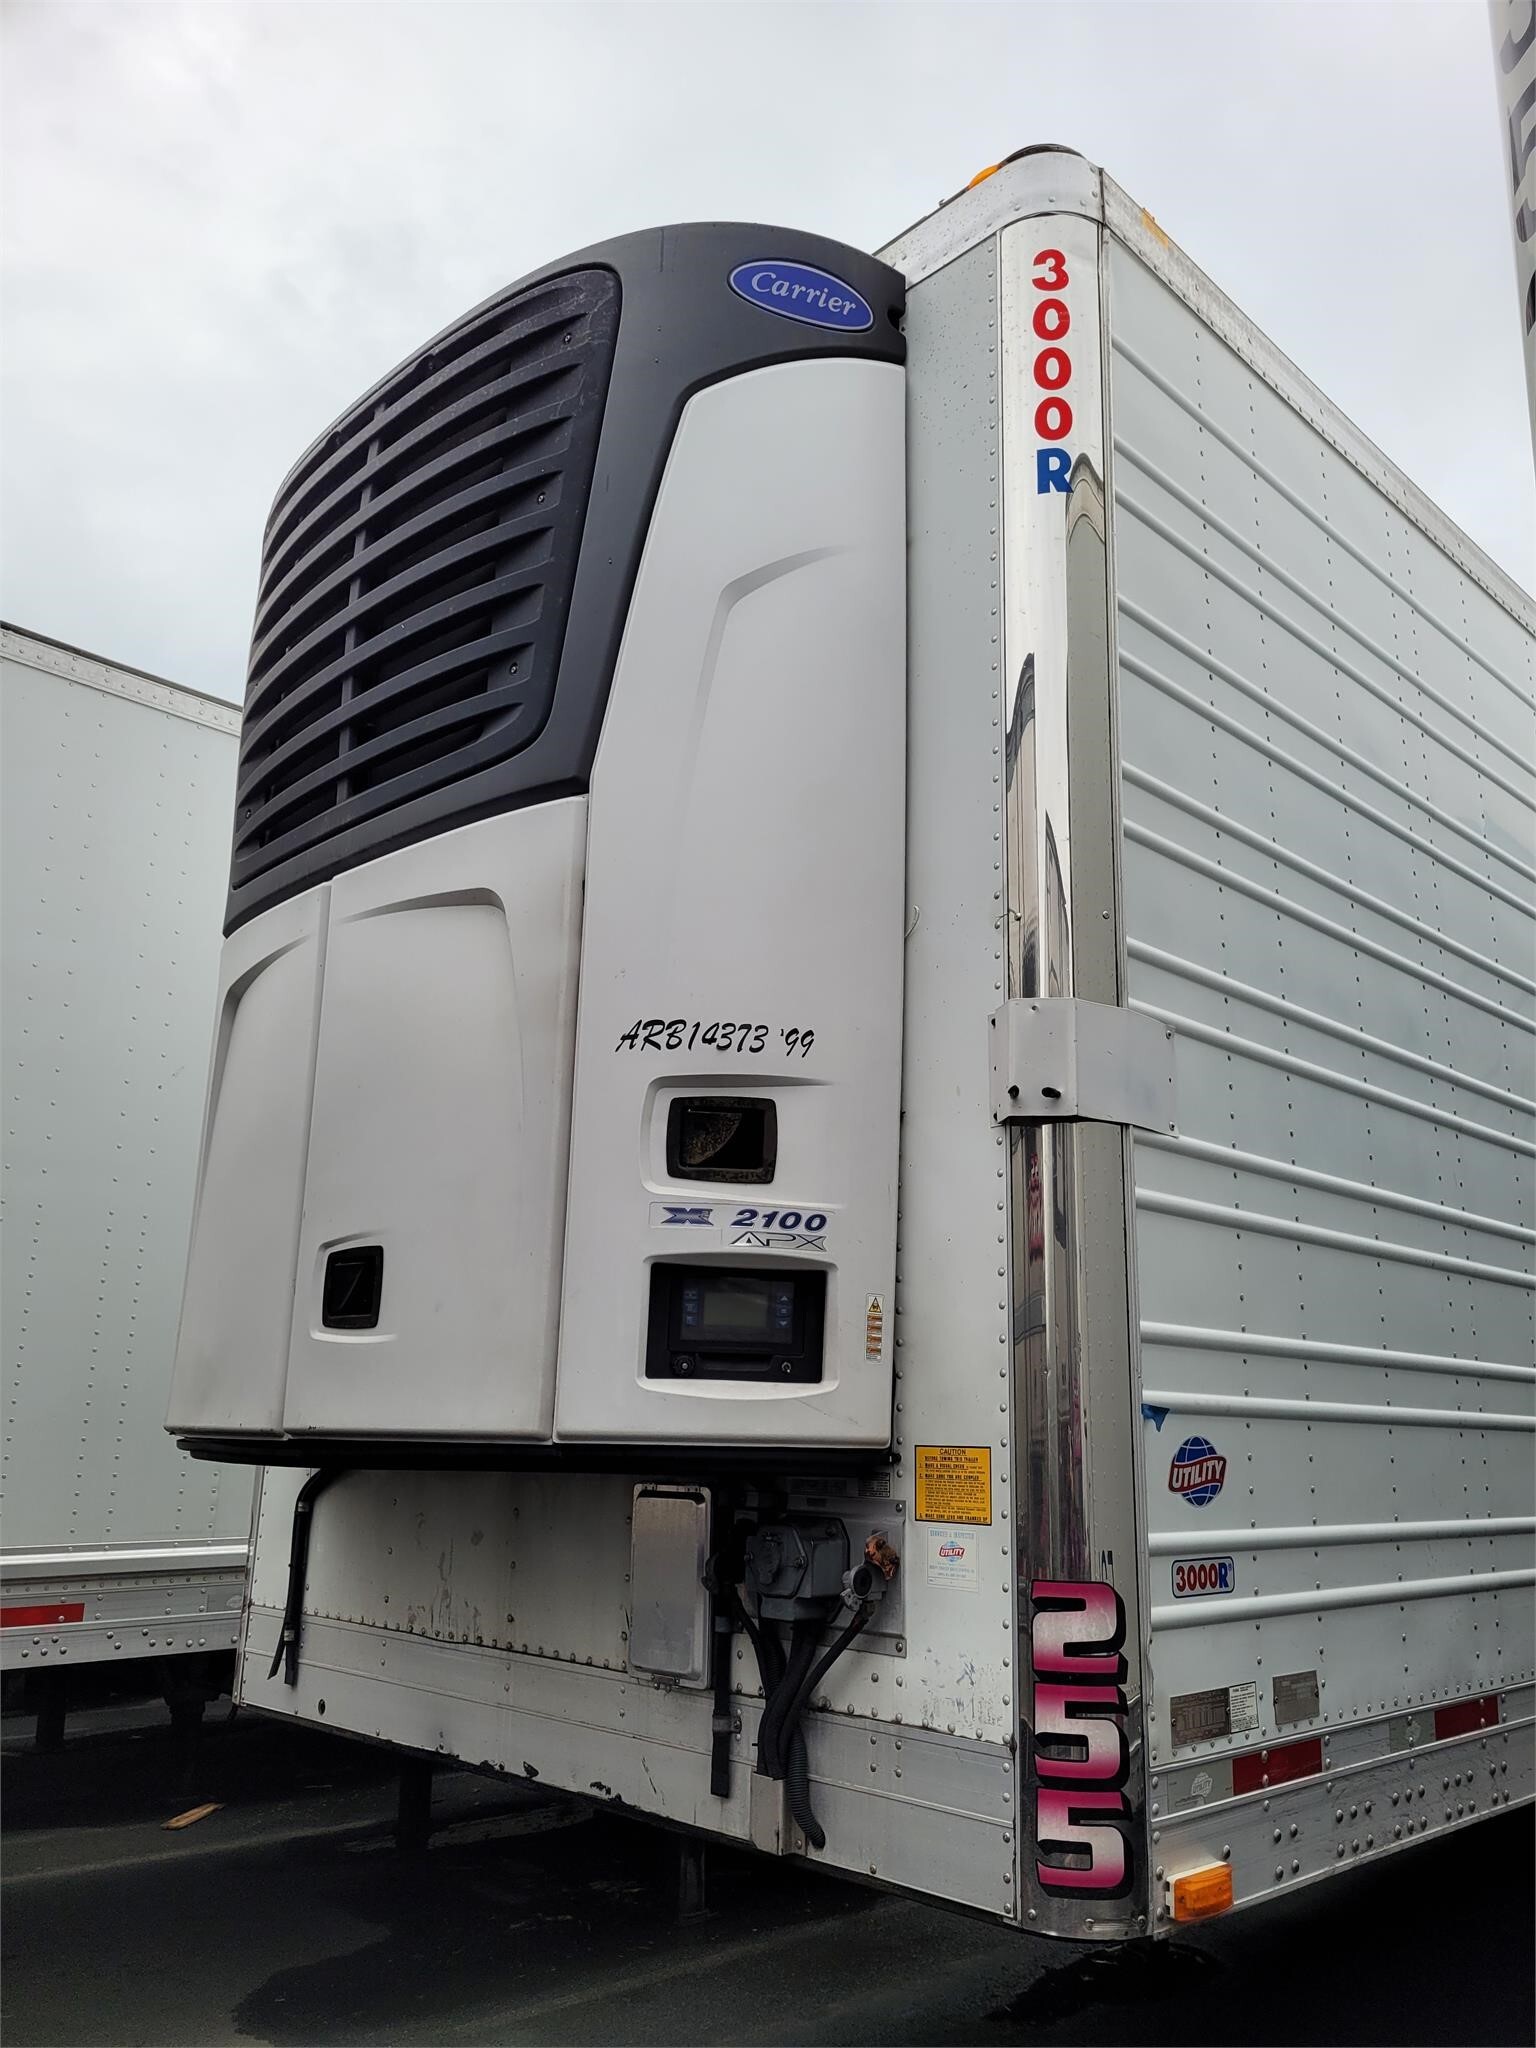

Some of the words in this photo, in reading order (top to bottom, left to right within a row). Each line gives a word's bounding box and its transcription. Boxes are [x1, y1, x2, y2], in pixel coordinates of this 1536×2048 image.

[751, 271, 857, 316] Carrier
[1031, 248, 1074, 495] 3000R
[614, 1018, 769, 1054] ARB14373
[730, 1208, 828, 1232] 2100
[729, 1231, 827, 1252] APX
[939, 1448, 967, 1456] CAUTION
[1172, 1460, 1224, 1489] UTILITY
[940, 1548, 964, 1557] UTILITY
[1030, 1579, 1134, 1900] 255
